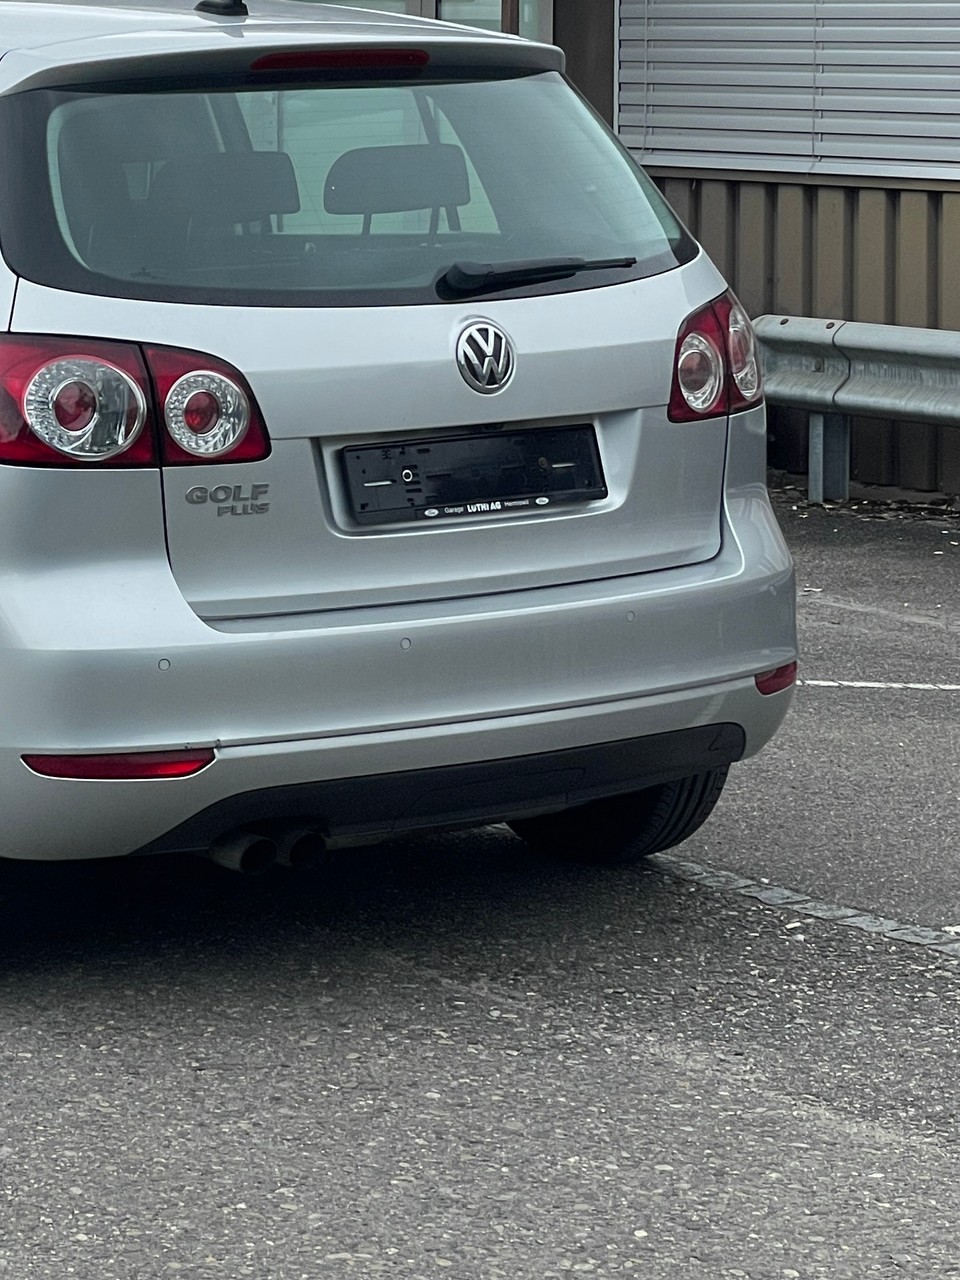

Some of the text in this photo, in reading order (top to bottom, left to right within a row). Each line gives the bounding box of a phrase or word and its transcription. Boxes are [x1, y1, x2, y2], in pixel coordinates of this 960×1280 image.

[185, 483, 269, 504] GOLF
[217, 503, 270, 517] PLUS
[490, 501, 502, 510] AG
